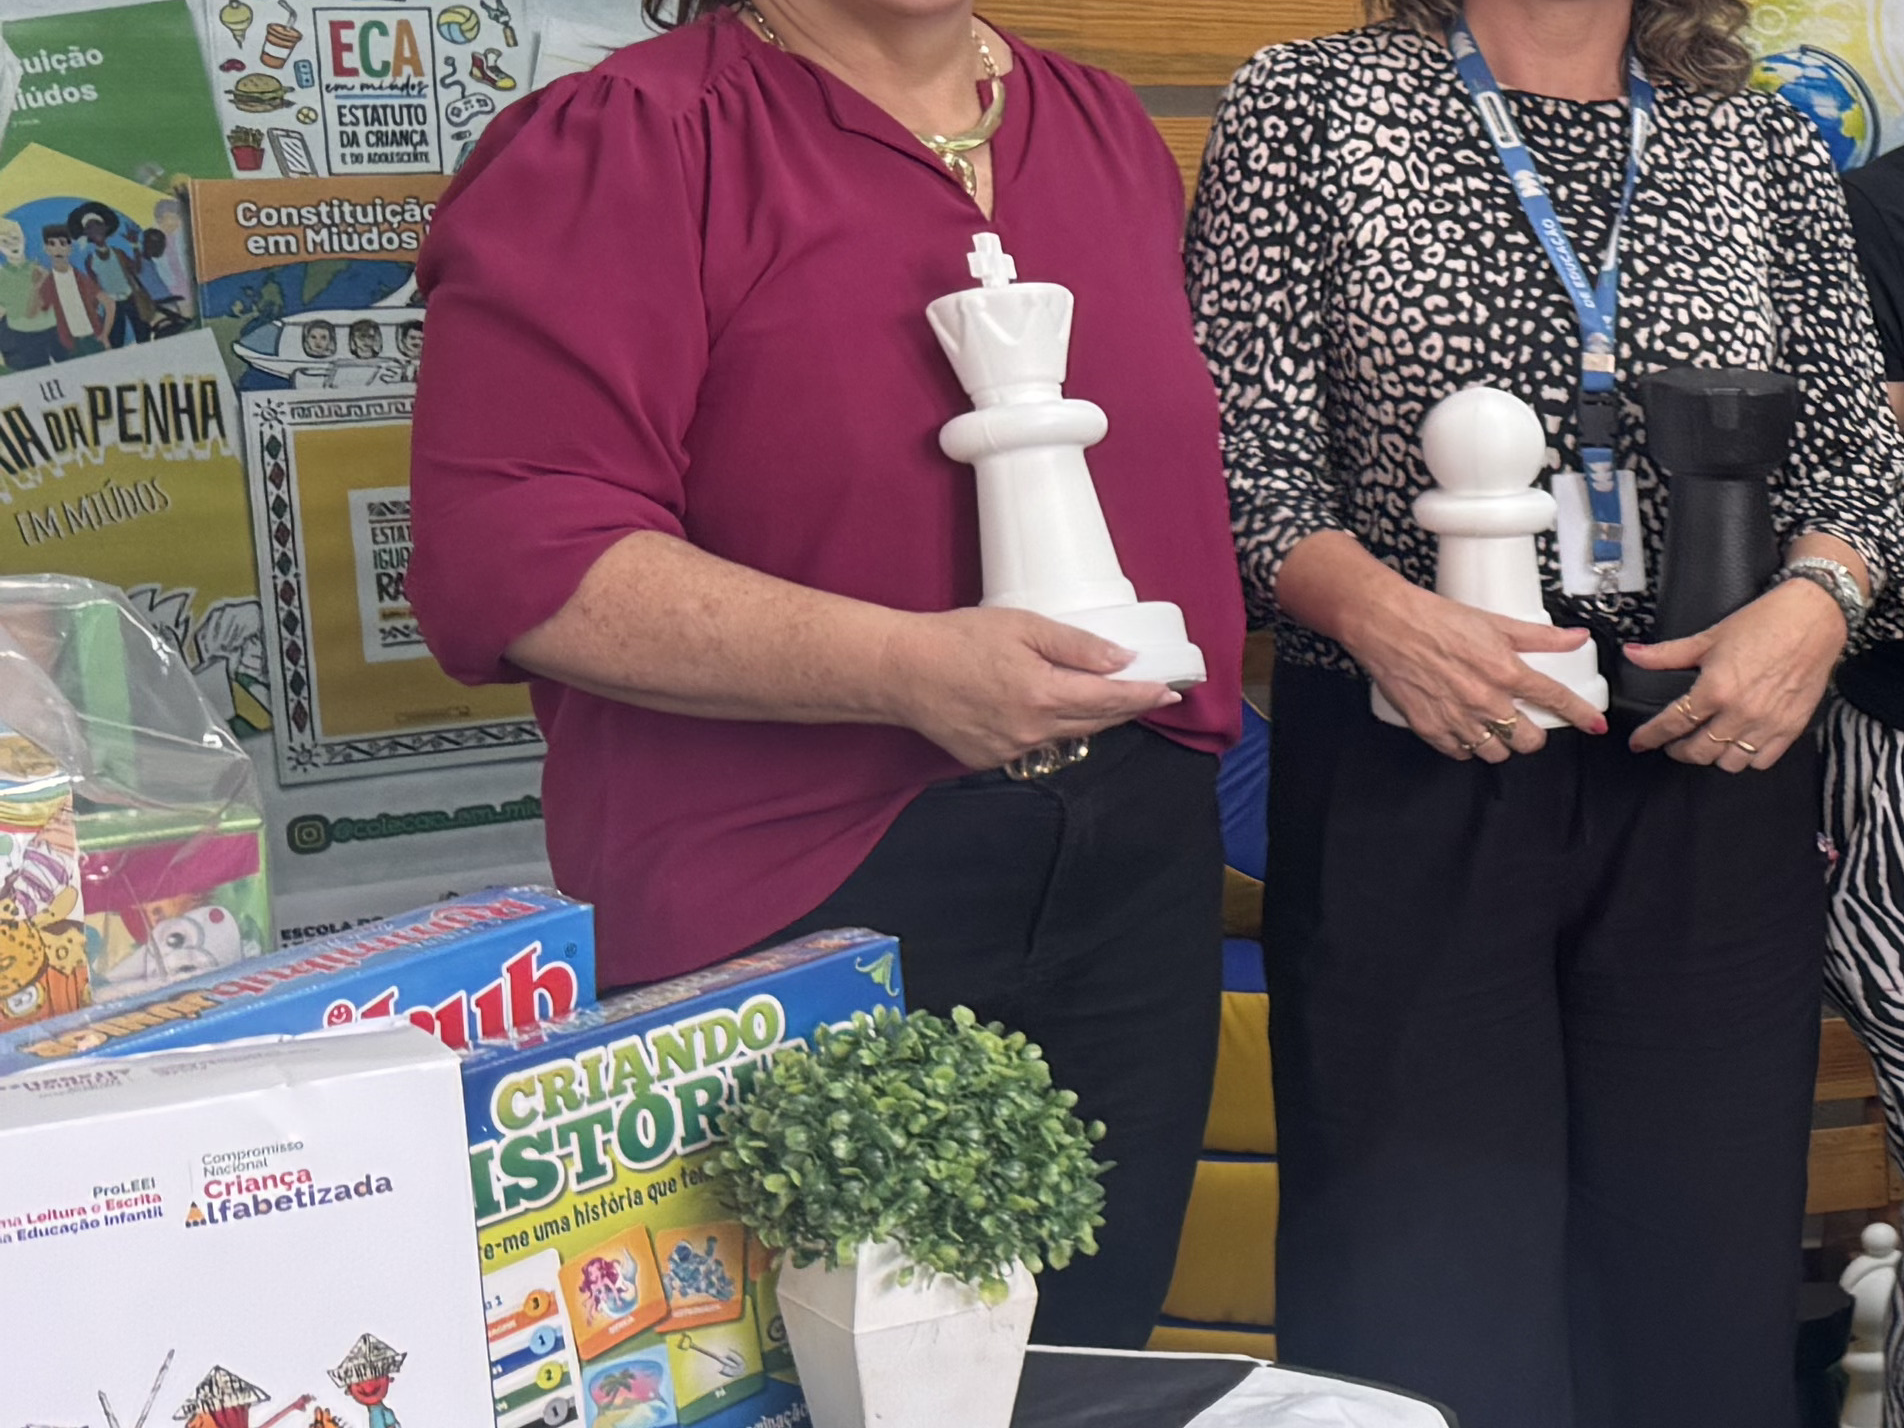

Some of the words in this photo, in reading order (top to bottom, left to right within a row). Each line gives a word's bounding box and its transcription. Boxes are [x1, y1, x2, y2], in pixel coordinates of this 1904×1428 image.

[22, 45, 105, 75] uição
[329, 18, 425, 79] ECA
[336, 103, 428, 128] ESTATUTO
[340, 129, 361, 149] DA
[365, 128, 430, 151] CRIANÇA
[340, 152, 348, 165] E
[350, 151, 364, 165] DO
[367, 149, 431, 164] ADOLESCENTE
[235, 196, 437, 230] Constituição
[246, 233, 299, 256] em
[304, 225, 418, 254] Miúdos
[43, 405, 90, 453] DA
[84, 379, 227, 448] PENHA
[14, 505, 66, 548] EM
[61, 477, 173, 536] MIÚDOS
[281, 921, 352, 941] ESCOLA
[494, 998, 782, 1133] CRIANDO
[201, 1139, 305, 1168] Compromisso
[202, 1156, 270, 1179] Nacional
[202, 1167, 313, 1201] Criança
[16, 1217, 101, 1243] Educação
[103, 1204, 165, 1228] Infantil
[26, 1204, 88, 1226] Leitura
[105, 1192, 164, 1213] Escrita
[532, 1217, 572, 1243] uma
[572, 1190, 644, 1232] história
[646, 1176, 678, 1207] que
